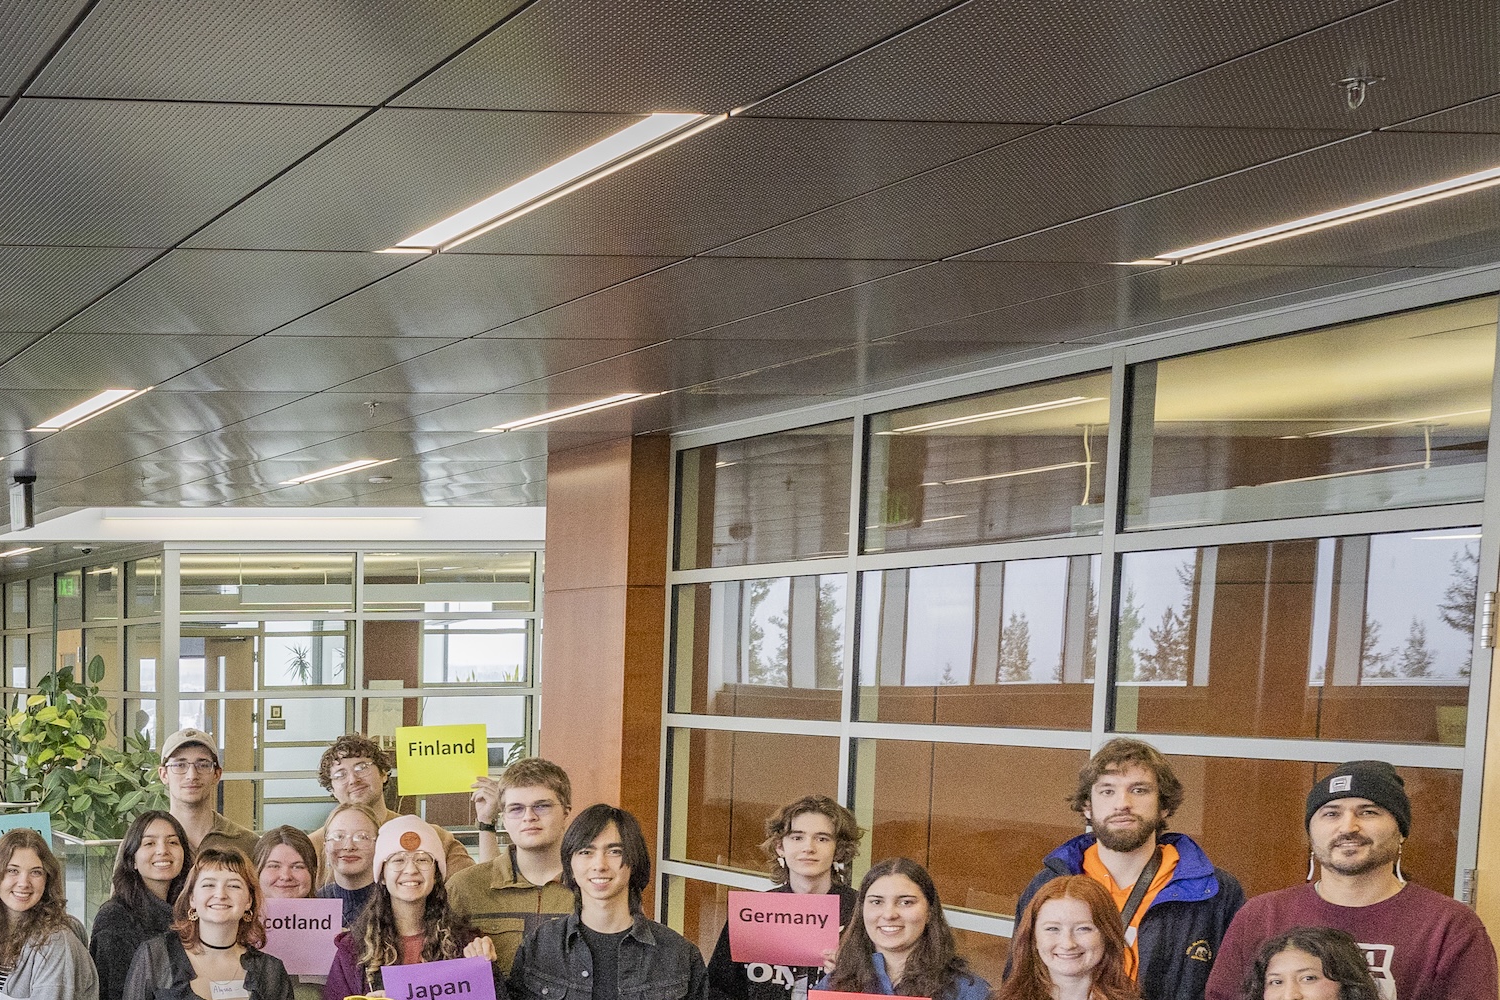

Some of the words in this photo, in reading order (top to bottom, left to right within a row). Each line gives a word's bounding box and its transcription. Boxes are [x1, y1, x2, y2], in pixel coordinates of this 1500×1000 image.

[409, 739, 476, 757] Finland
[263, 914, 332, 930] cotland
[739, 908, 829, 929] Germany
[406, 980, 471, 1000] Japan
